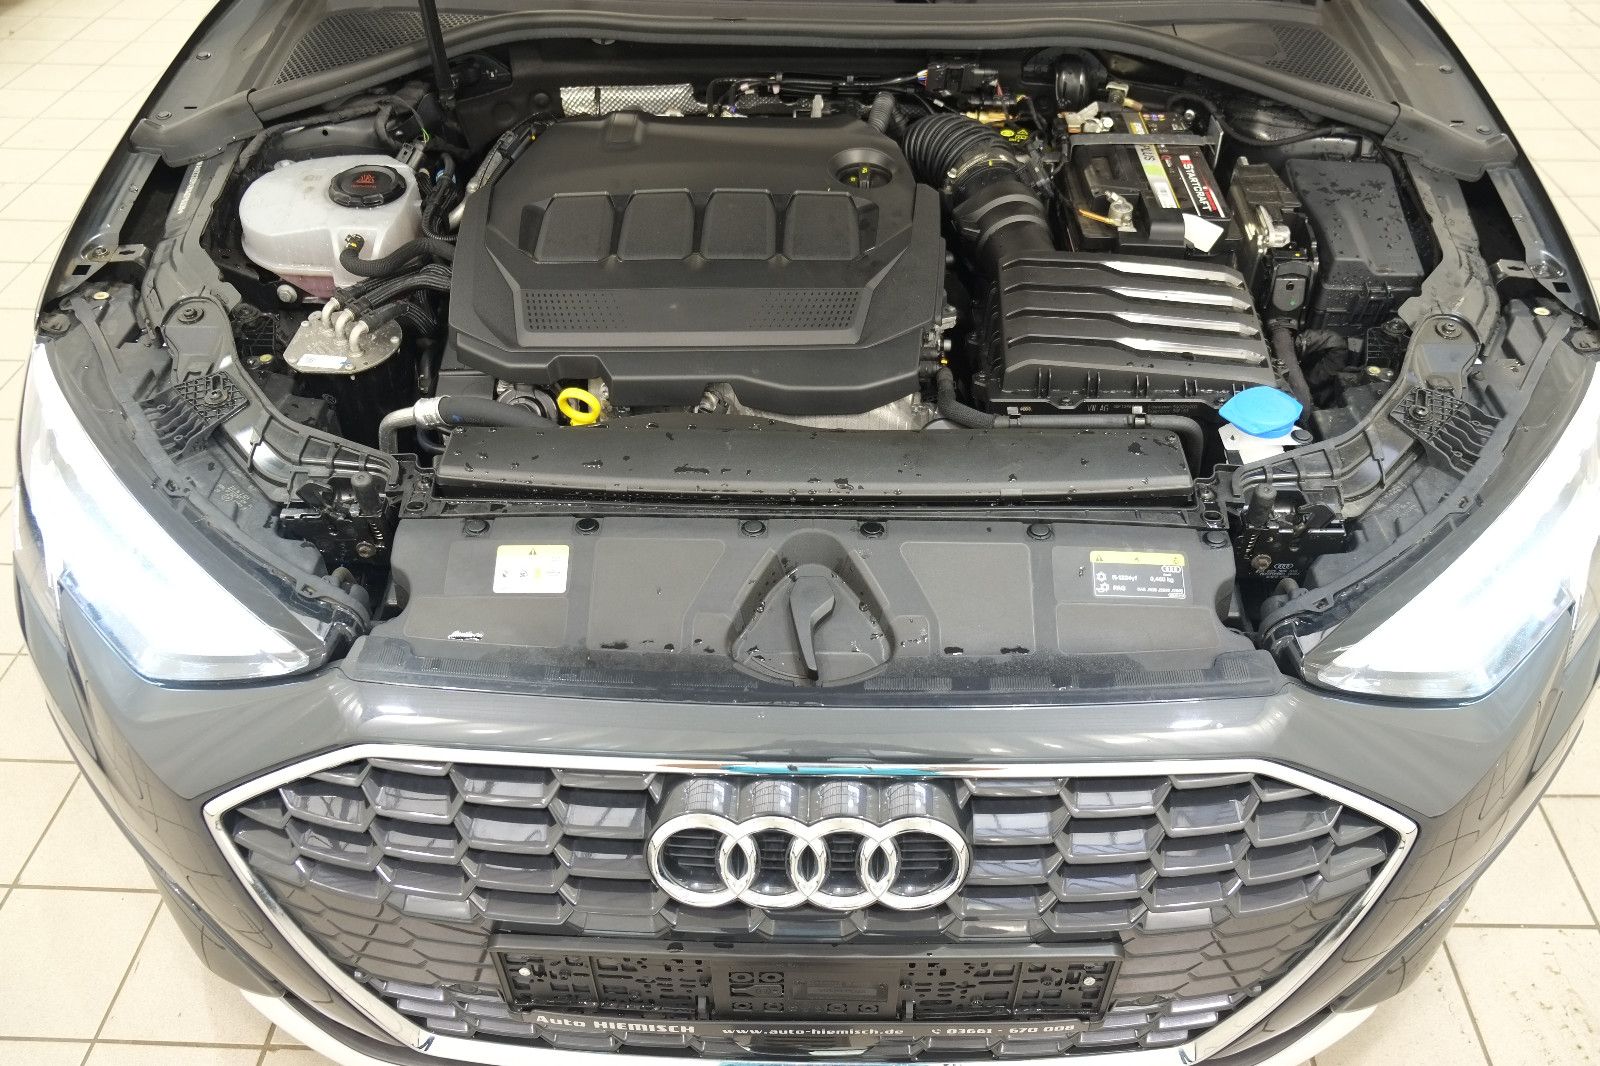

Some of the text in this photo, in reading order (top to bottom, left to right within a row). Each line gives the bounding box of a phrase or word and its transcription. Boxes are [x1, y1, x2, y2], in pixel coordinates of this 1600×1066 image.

[1183, 163, 1213, 211] STARTCRAFT
[536, 1015, 695, 1033] Auto HIEMISCH
